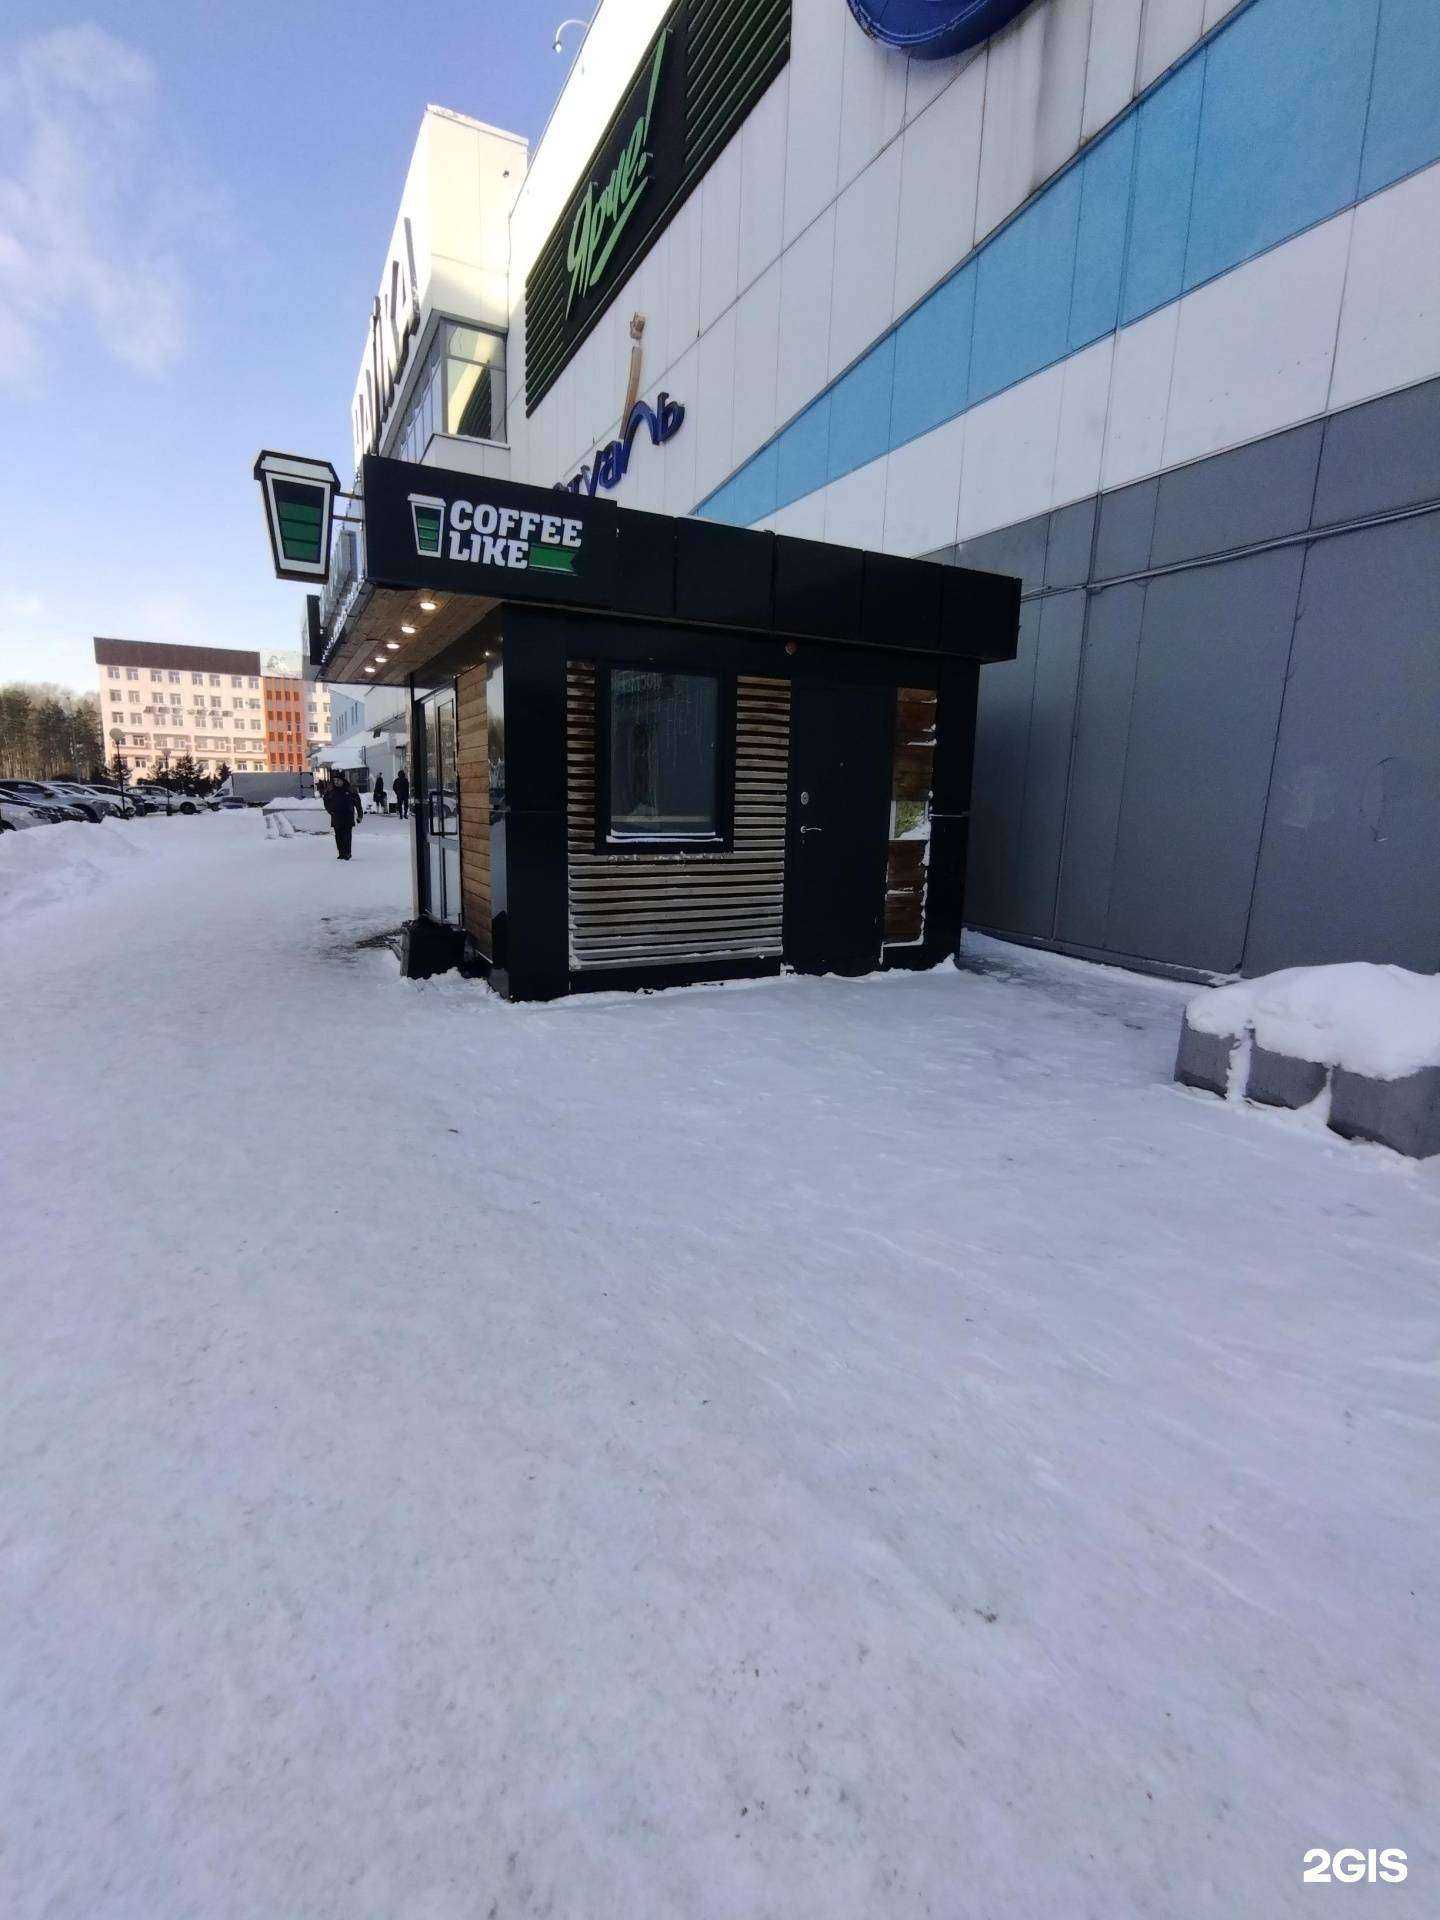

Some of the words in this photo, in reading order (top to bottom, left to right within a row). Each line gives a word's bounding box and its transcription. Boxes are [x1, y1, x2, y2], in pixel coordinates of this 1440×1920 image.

[566, 28, 668, 320] Ярче!
[450, 500, 583, 548] COFFEE
[449, 531, 529, 570] LIKE
